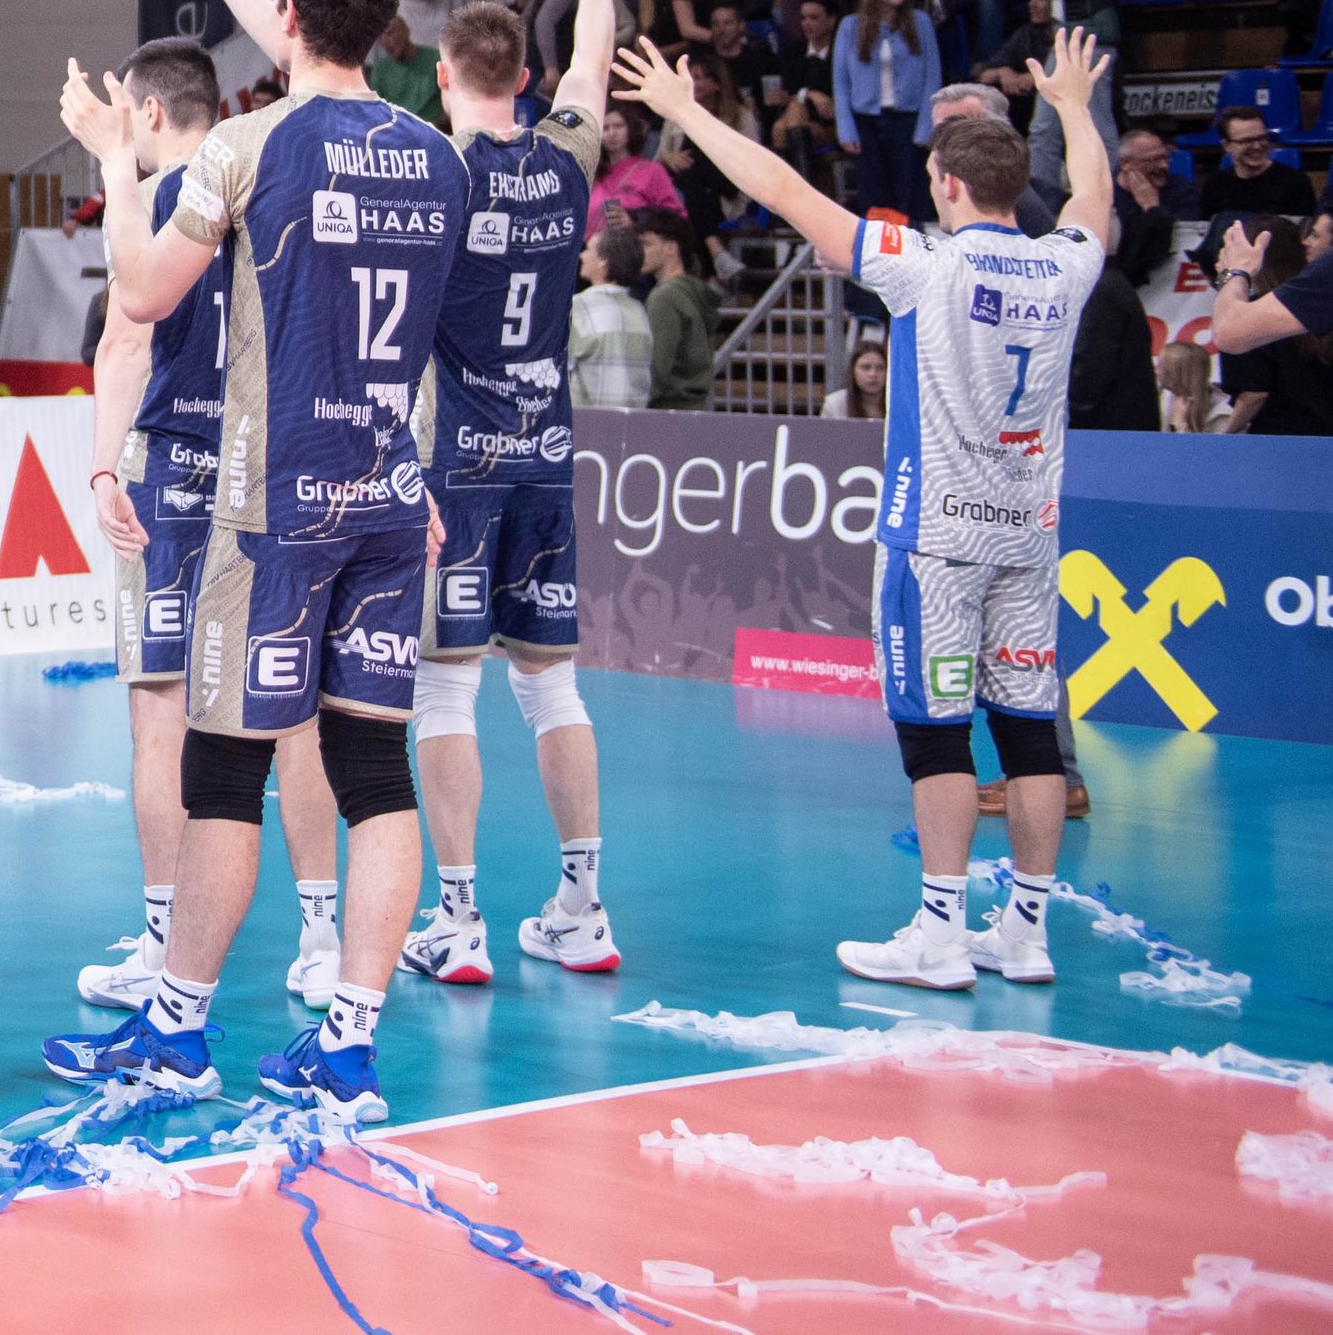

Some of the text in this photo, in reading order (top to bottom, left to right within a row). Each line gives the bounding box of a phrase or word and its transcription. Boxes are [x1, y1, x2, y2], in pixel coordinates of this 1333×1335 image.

[324, 138, 429, 181] MÜLLEDER
[359, 195, 447, 211] GeneralAgentur
[359, 209, 446, 234] HAAS
[316, 221, 354, 235] UNIQA
[471, 236, 504, 247] UNIQA
[511, 216, 574, 242] HAAS
[351, 266, 409, 361] 12
[501, 271, 537, 347] 9
[1004, 343, 1032, 416] 7
[457, 425, 540, 457] Grabner
[228, 440, 247, 510] nine
[296, 475, 390, 501] Grabner
[886, 478, 912, 528] nine
[942, 494, 1032, 528] Grabner
[203, 620, 223, 687] nine
[258, 647, 301, 686] E
[889, 625, 904, 678] nine
[936, 659, 969, 694] E
